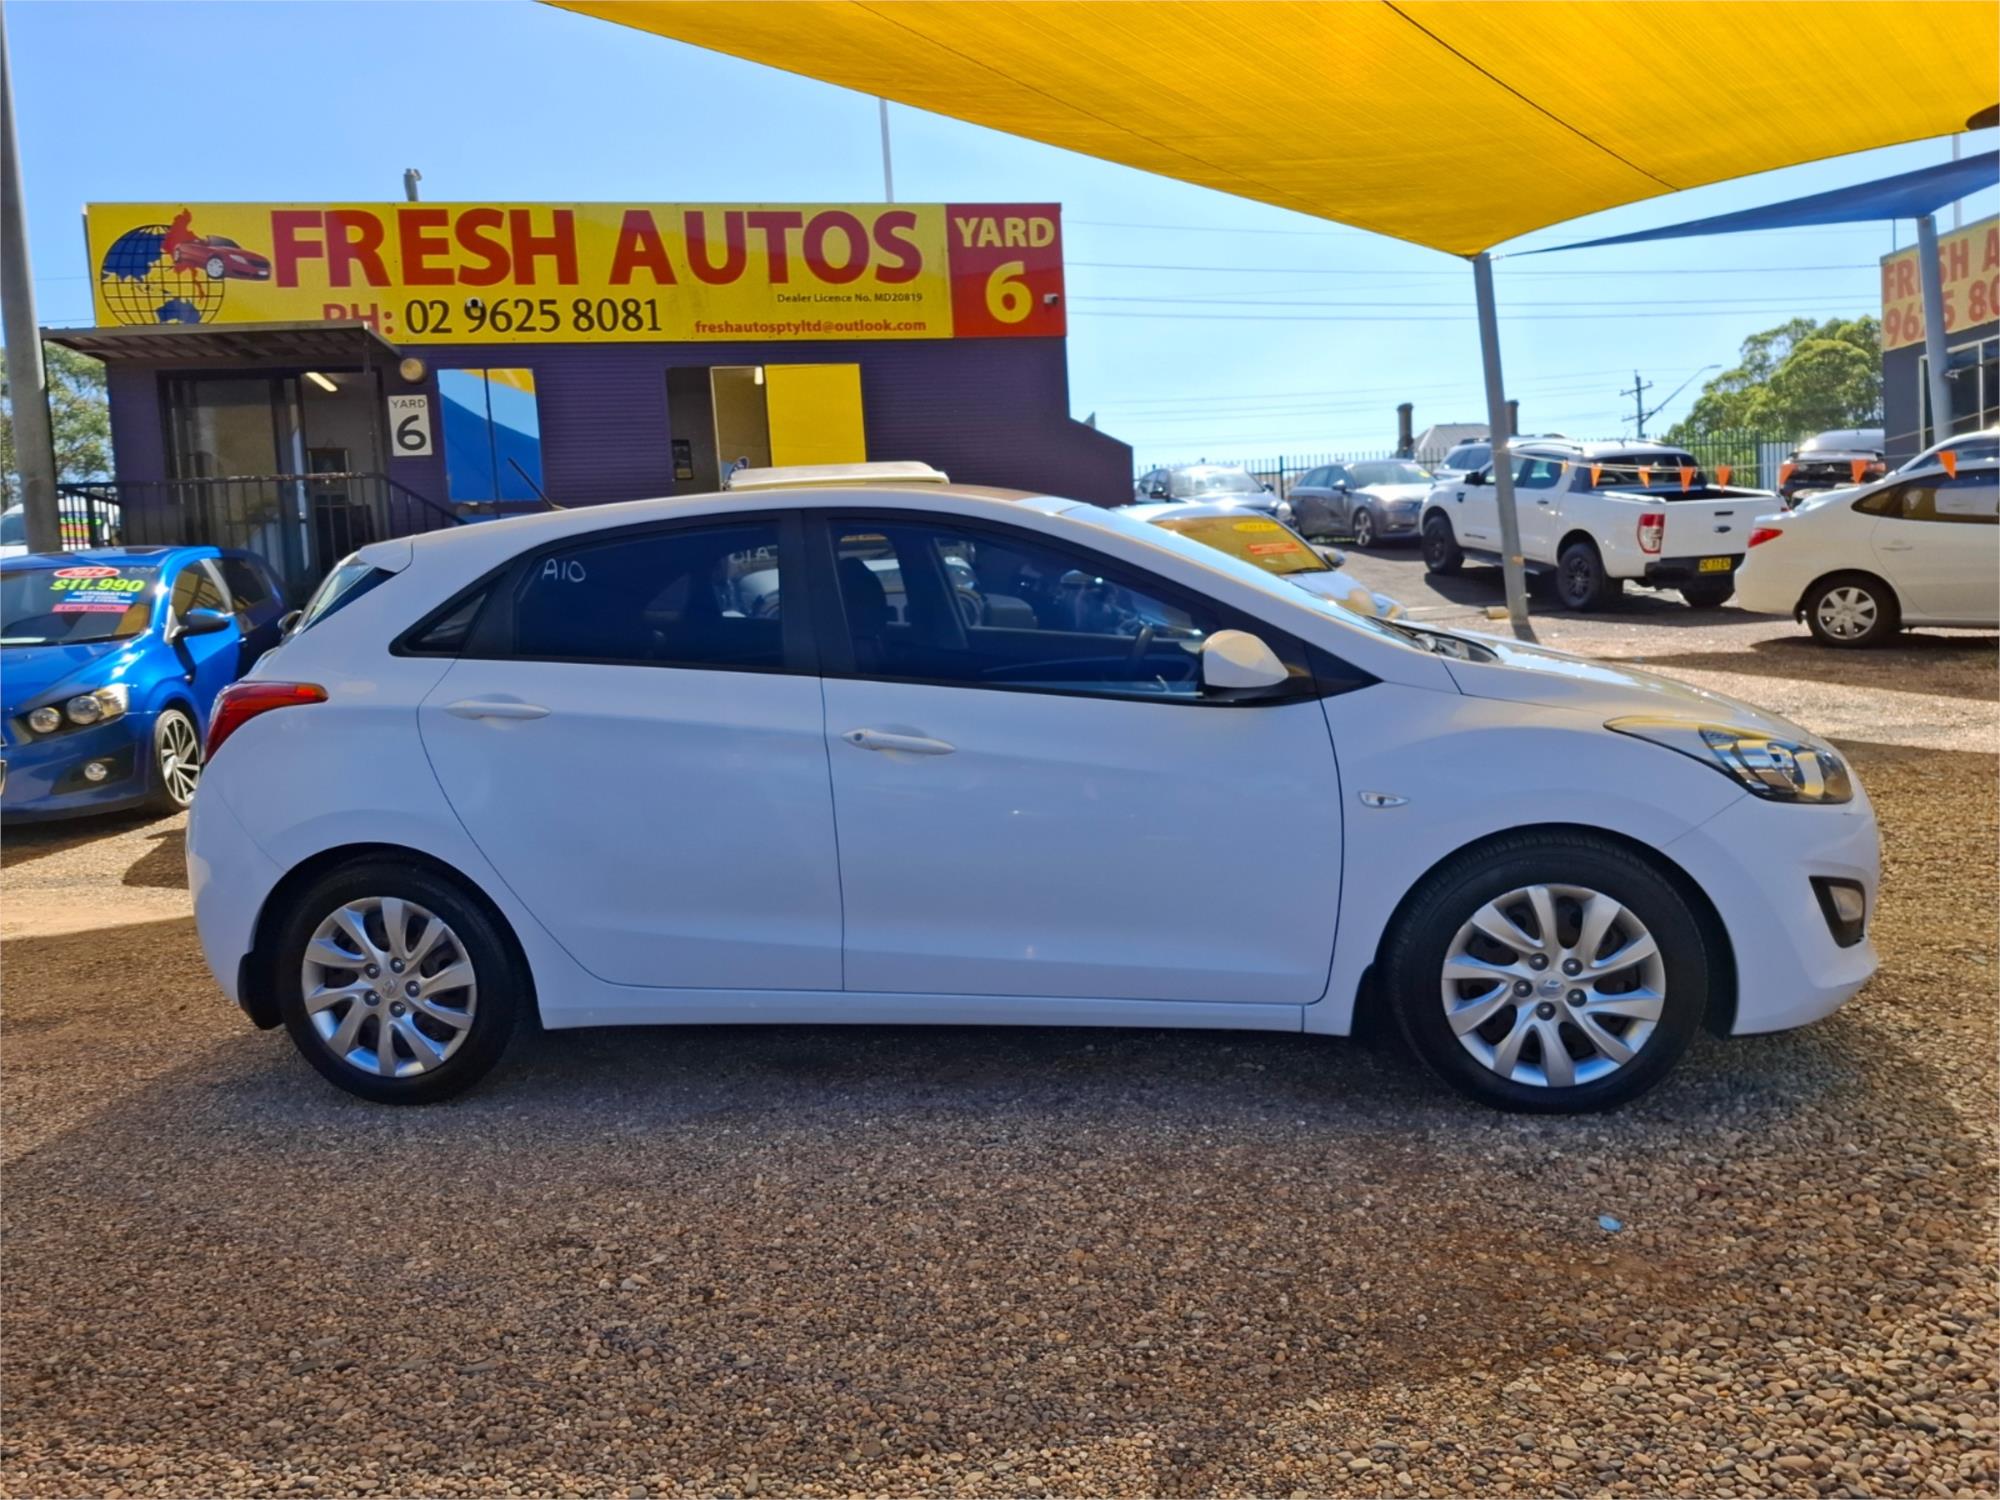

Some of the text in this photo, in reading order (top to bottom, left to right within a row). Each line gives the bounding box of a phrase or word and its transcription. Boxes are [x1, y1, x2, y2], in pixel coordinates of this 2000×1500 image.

[270, 209, 923, 288] FRESH AUTOS
[955, 217, 1055, 248] YARD
[777, 293, 923, 303] Dealer Licence No. MD20819
[985, 261, 1032, 324] 6
[405, 299, 453, 334] 02
[464, 299, 560, 333] 9625
[573, 298, 662, 332] 8081
[695, 320, 927, 336] freshautosptyltd@outlook.com
[391, 399, 426, 408] YARD
[396, 414, 427, 451] 6
